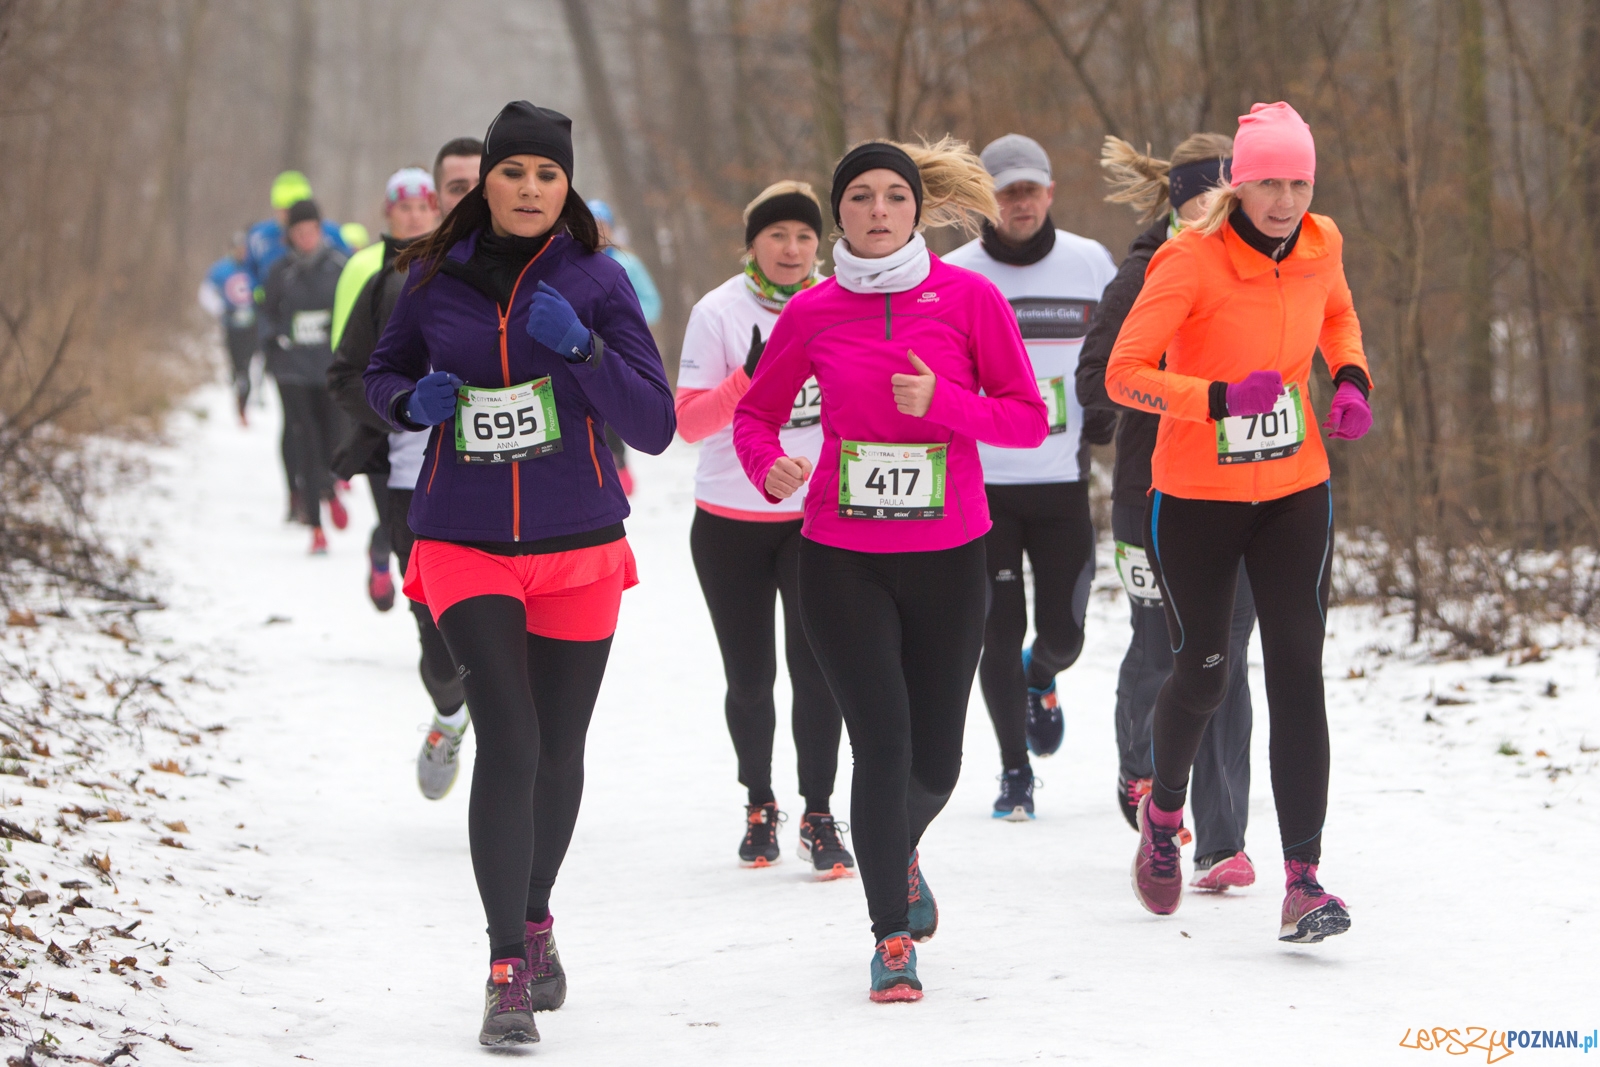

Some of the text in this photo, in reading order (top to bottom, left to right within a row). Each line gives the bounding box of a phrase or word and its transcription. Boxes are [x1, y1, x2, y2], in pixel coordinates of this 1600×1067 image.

[473, 406, 537, 440] 695
[1241, 408, 1289, 440] 701
[496, 441, 519, 450] ANNA
[865, 467, 920, 496] 417
[879, 498, 904, 506] PAULA
